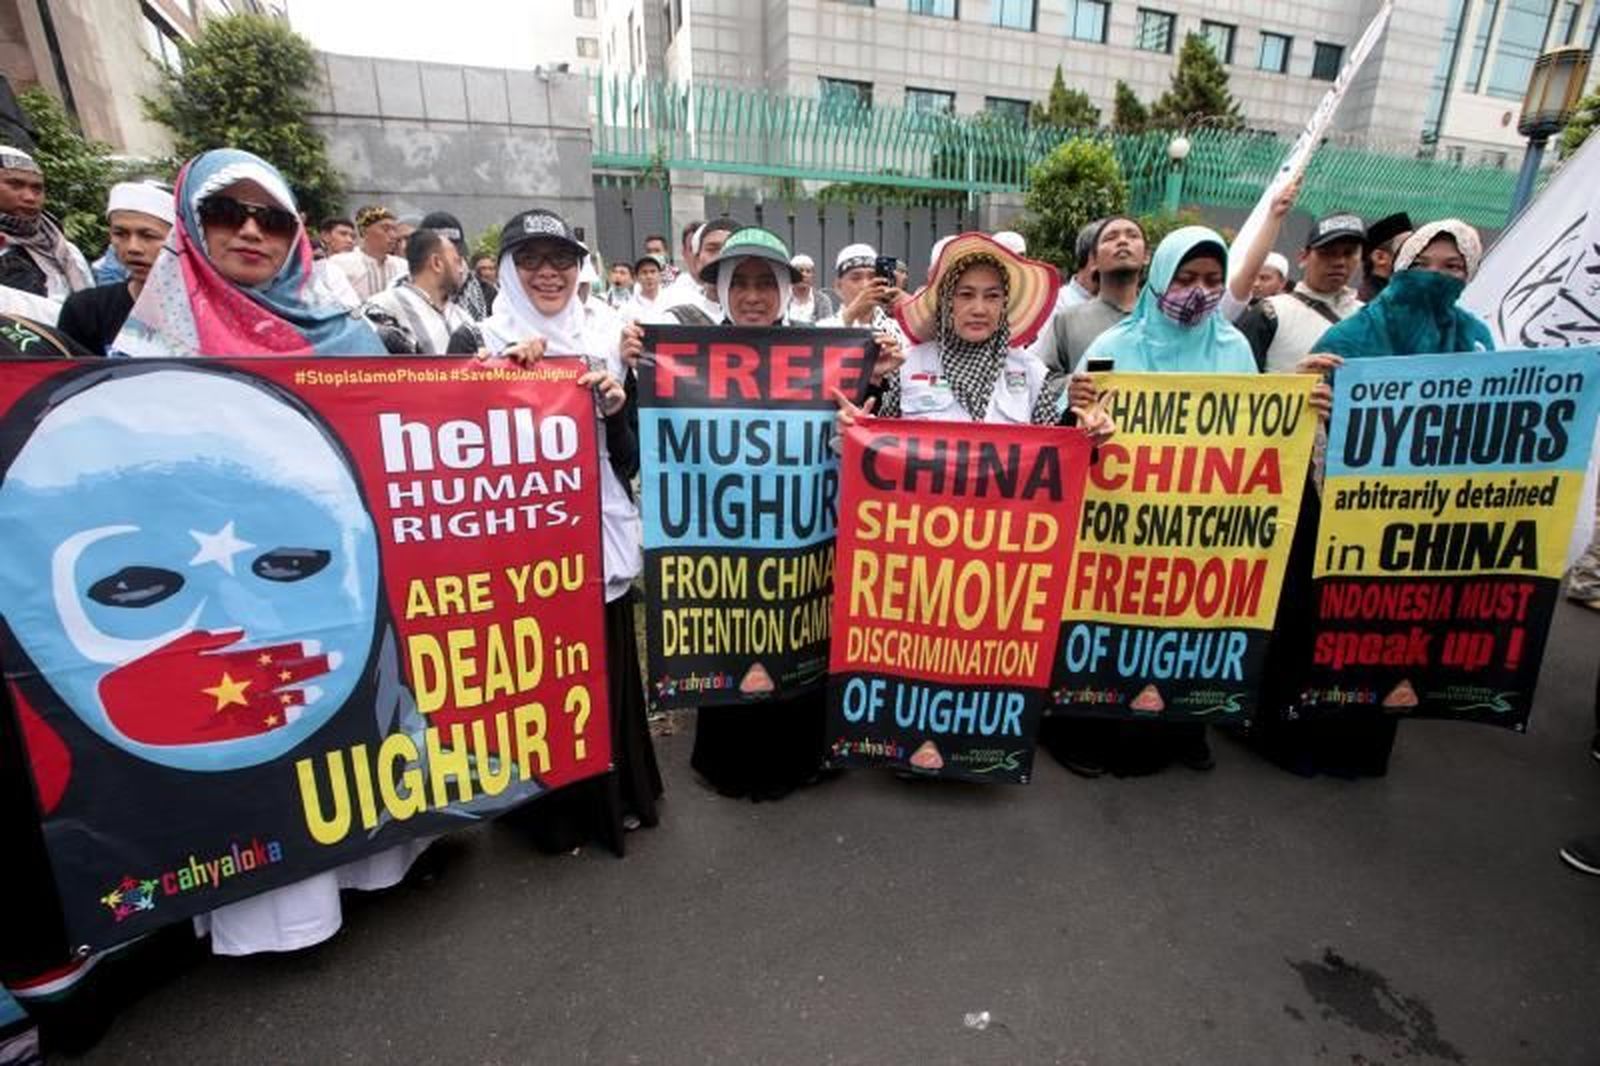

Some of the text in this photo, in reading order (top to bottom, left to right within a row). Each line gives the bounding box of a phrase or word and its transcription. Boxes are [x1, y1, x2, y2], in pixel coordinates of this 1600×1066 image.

[655, 342, 867, 399] FREE
[1351, 367, 1584, 401] over one million
[379, 408, 578, 473] hello
[1097, 388, 1304, 437] HAME ON YOU
[1342, 399, 1576, 468] UYGHURS
[387, 467, 582, 509] HUMAN
[861, 435, 1063, 503] CHINA
[1090, 442, 1283, 495] CHINA
[1335, 476, 1558, 517] arbitrarily detained
[392, 501, 582, 544] RIGHTS,
[658, 469, 839, 540] UIGHUR
[854, 500, 1058, 553] SHOULD
[1080, 500, 1278, 549] FOR SNATCHING
[660, 545, 836, 601] FROM CHINA
[1326, 519, 1537, 571] in CHINA
[405, 554, 585, 620] ARE YOU
[849, 550, 1053, 632] REMOVE
[1072, 552, 1268, 619] FREEDOM
[1321, 581, 1535, 622] INDONESIA MUST
[662, 606, 783, 657] DETENTION
[847, 626, 1039, 677] DISCRIMINATION
[1065, 624, 1248, 682] OF UIGHUR
[1313, 629, 1523, 674] speak up !
[407, 616, 589, 714] DEAD in
[843, 677, 1025, 737] OF UIGHUR
[296, 686, 592, 846] UIGHUR ?
[162, 839, 283, 895] cahyaloka
